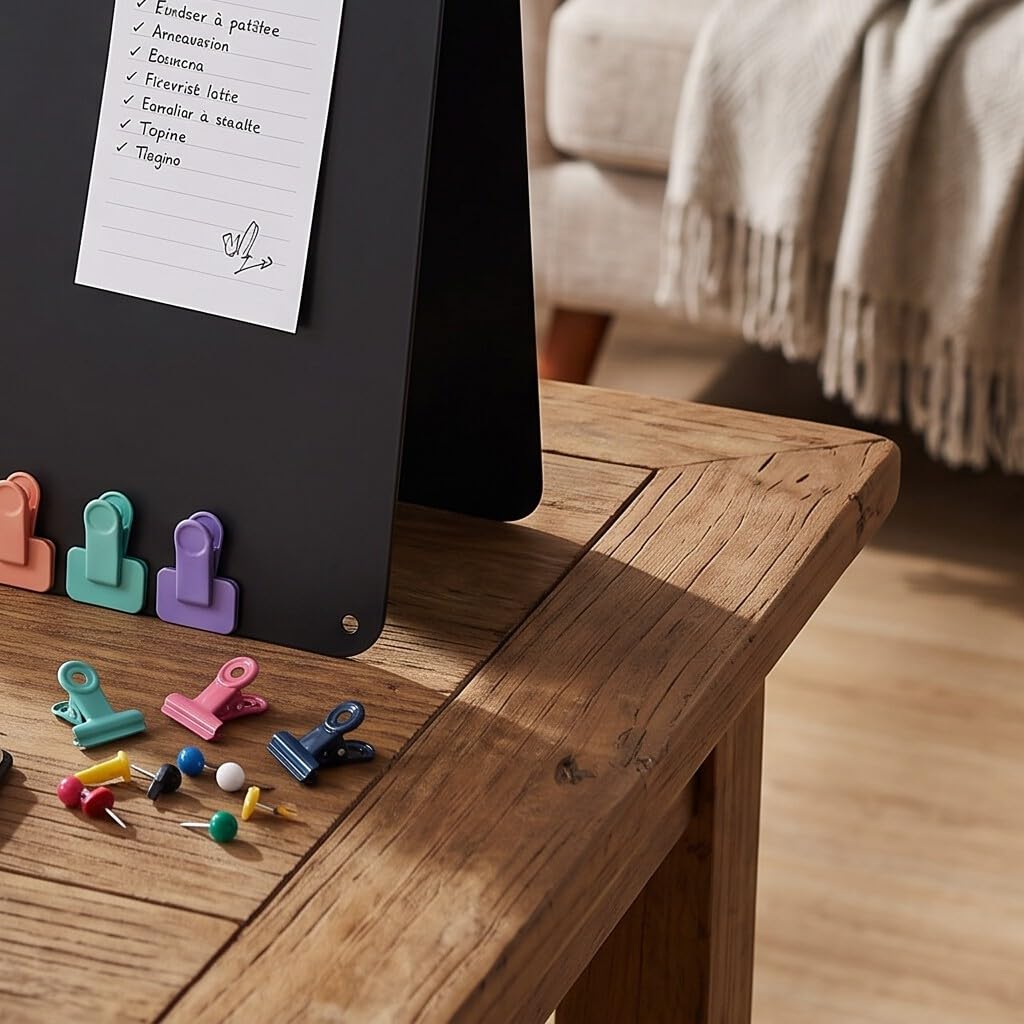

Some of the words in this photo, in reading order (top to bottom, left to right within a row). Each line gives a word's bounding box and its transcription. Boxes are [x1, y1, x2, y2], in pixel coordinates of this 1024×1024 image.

[214, 12, 223, 26] à
[200, 110, 209, 123] à
[140, 121, 186, 143] Topine
